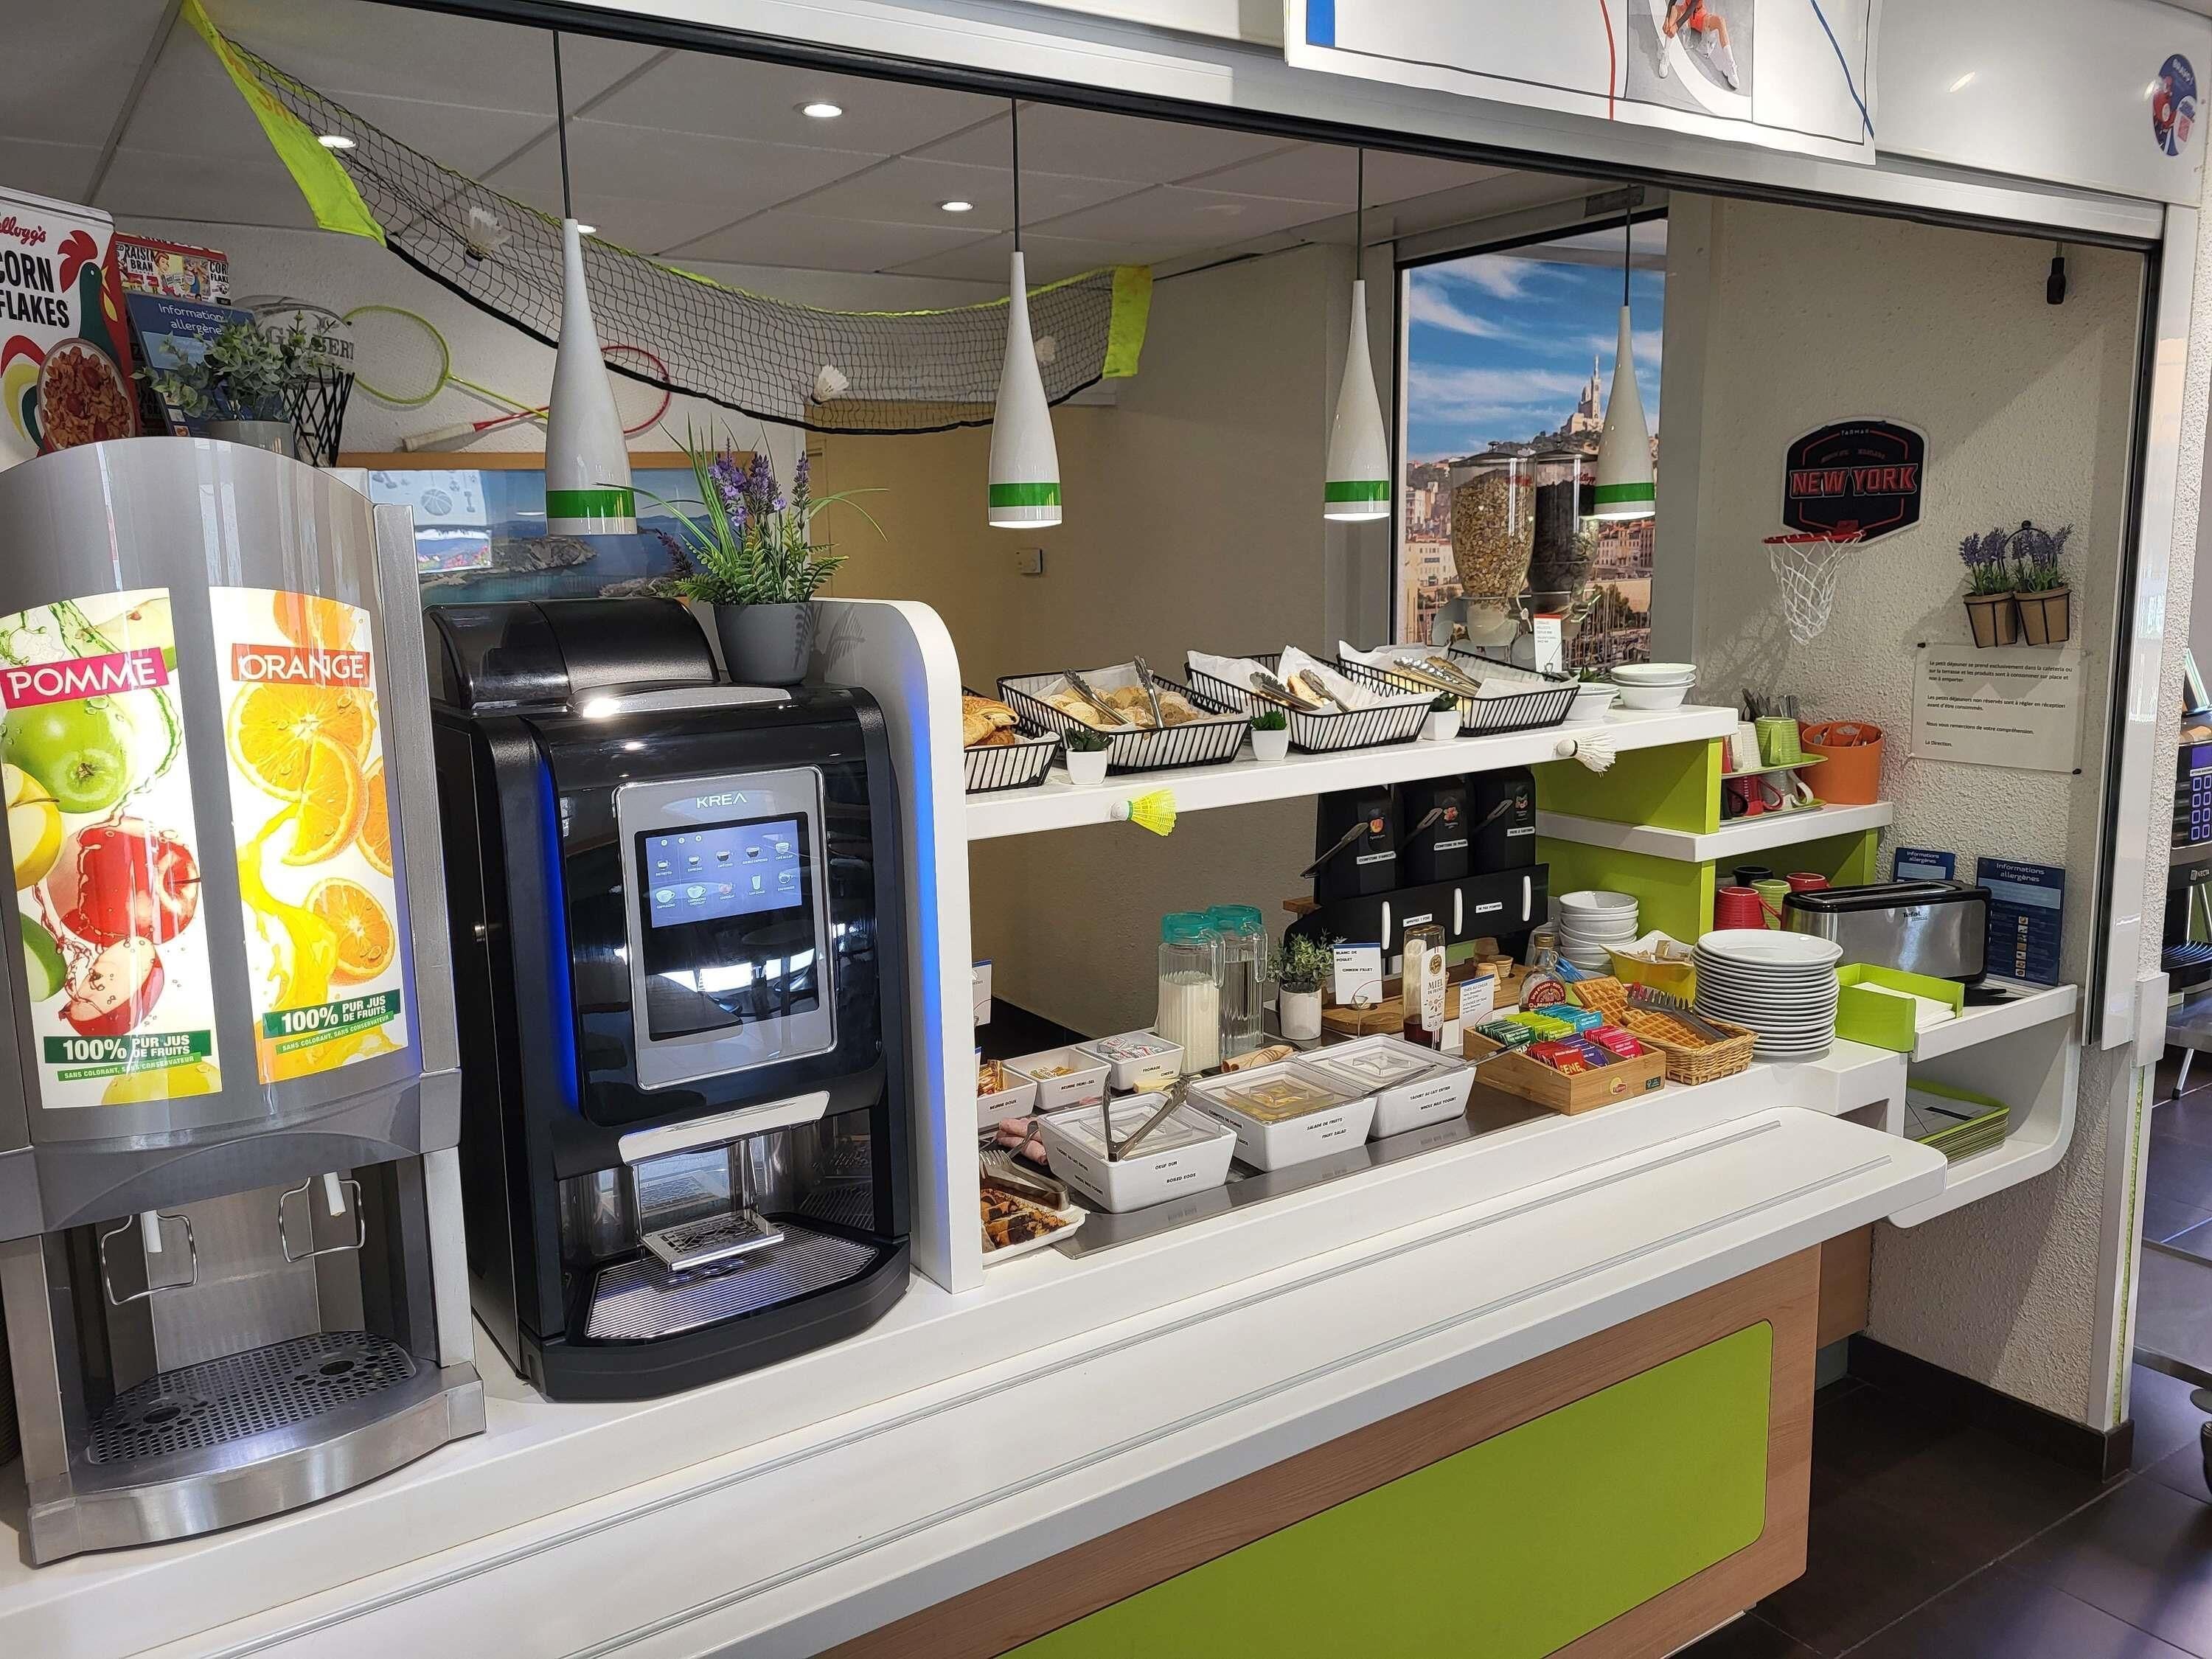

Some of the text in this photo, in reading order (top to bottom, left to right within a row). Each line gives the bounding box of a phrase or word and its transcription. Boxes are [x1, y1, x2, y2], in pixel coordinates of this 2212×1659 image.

[0, 216, 46, 246] llogg's
[131, 259, 154, 273] BRAN
[158, 303, 225, 321] Information
[170, 319, 225, 336] allergène
[1790, 466, 1917, 497] NEW YORK
[240, 654, 364, 680] ORANGE
[7, 658, 157, 700] POMME
[1907, 851, 1939, 859] Informations
[1908, 856, 1937, 864] allergènes
[1996, 862, 2045, 875] Informations
[2000, 871, 2040, 883] allergènes
[1427, 978, 1443, 990] MIEL
[342, 995, 386, 1013] PUR JUS
[282, 1005, 339, 1033] 100%
[343, 1005, 386, 1023] DE FRUITS
[132, 1034, 190, 1048] PUR JUS
[282, 1015, 389, 1051] SANS COLORANT, SANS CONSERVATEUR
[63, 1038, 127, 1061] 100%
[132, 1046, 190, 1058] DE FRUITS
[64, 1056, 195, 1079] SANS COLORANT, SNS CONSERVATEUR
